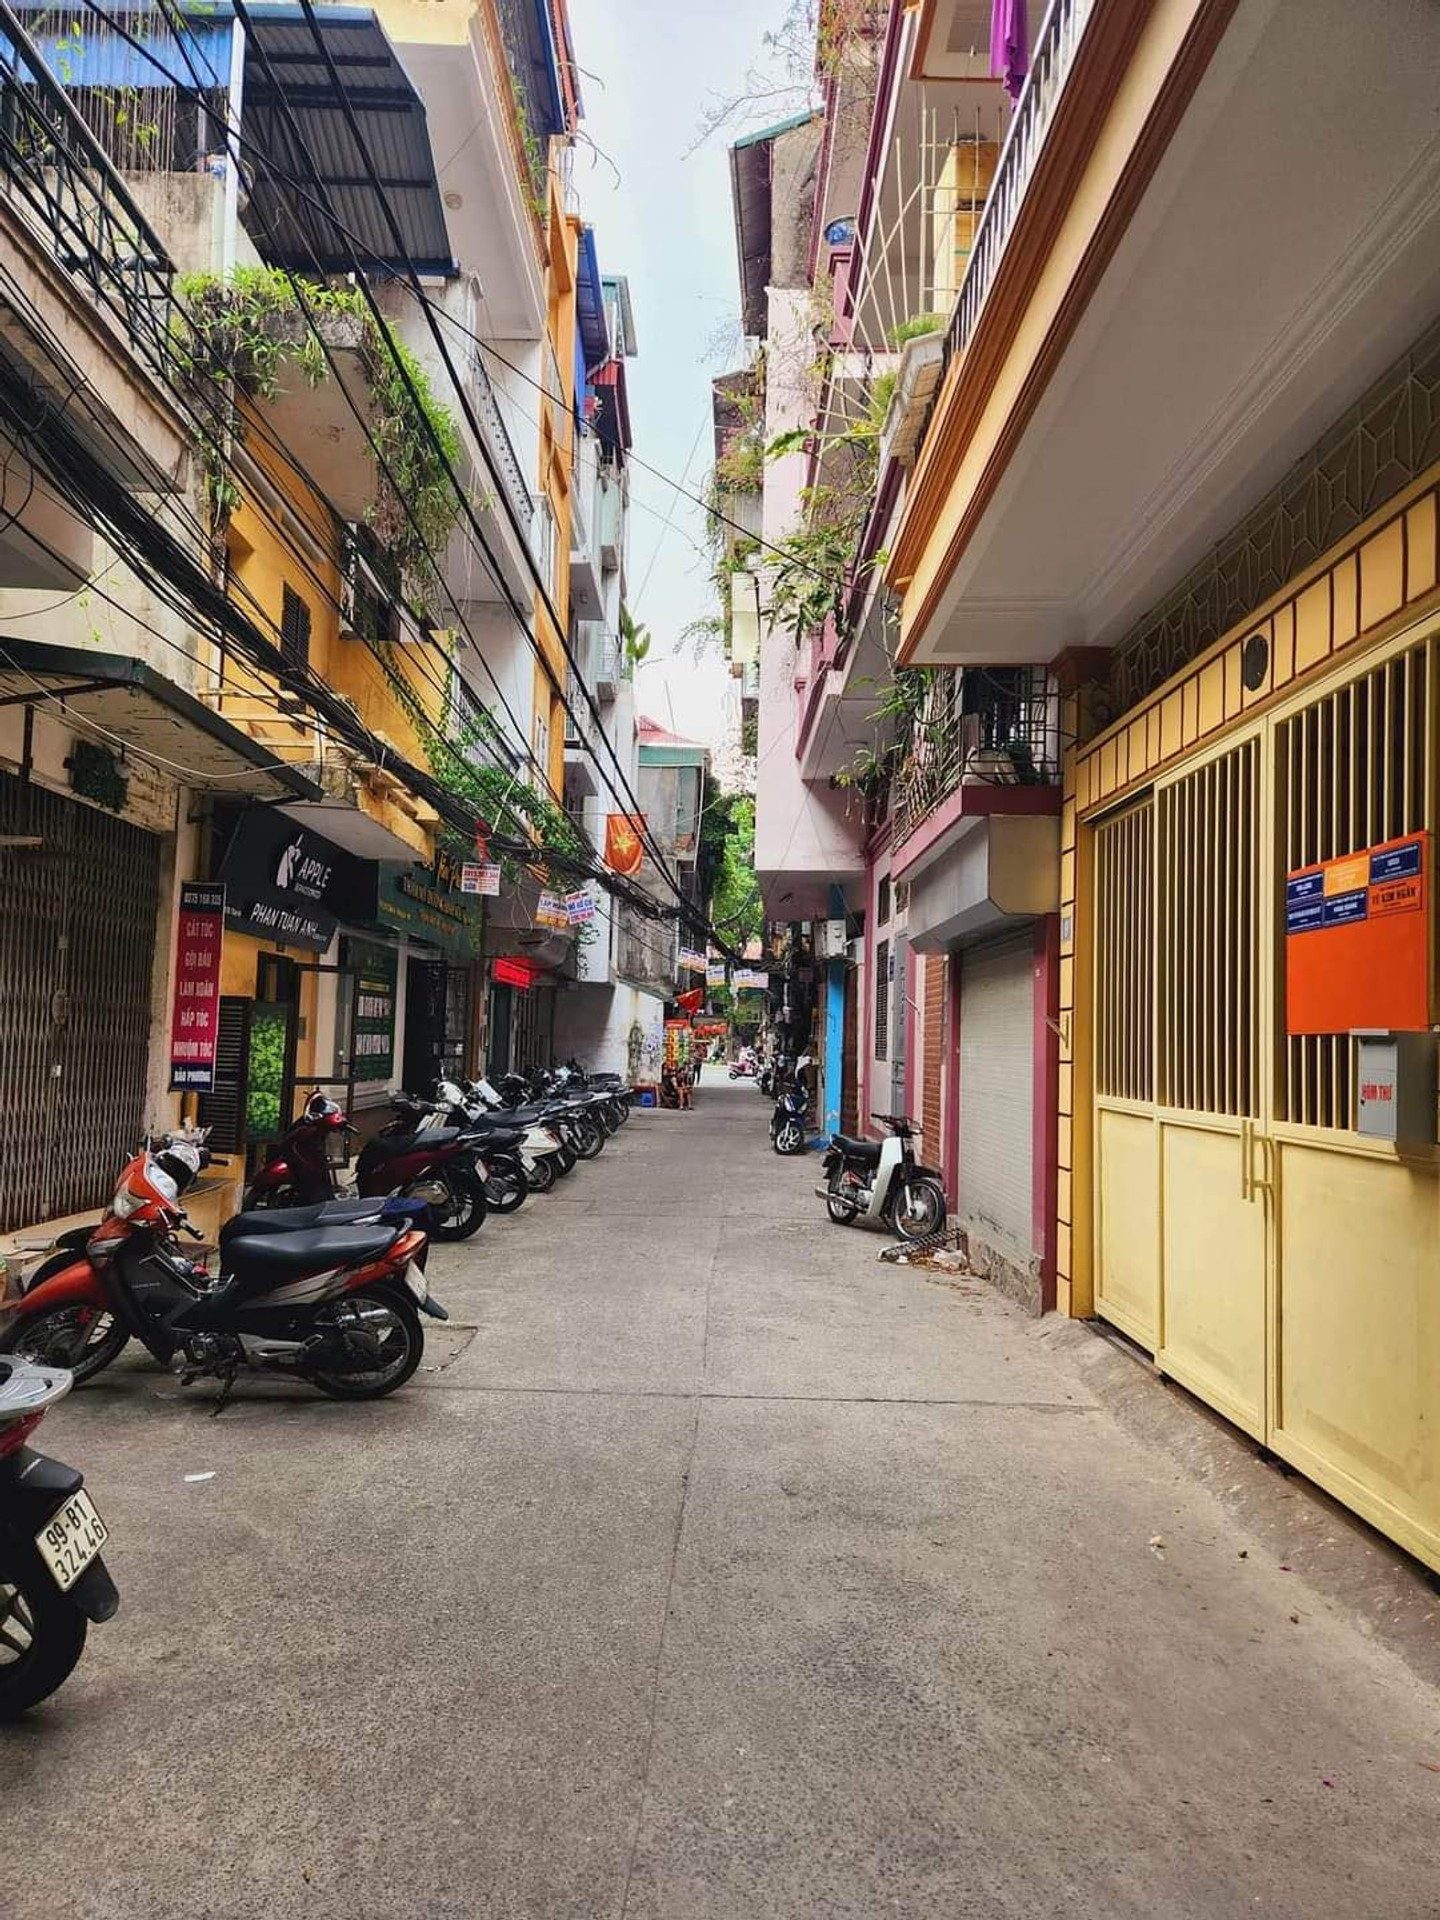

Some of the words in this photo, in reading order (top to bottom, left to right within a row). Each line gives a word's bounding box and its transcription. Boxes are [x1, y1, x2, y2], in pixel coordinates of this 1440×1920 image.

[298, 857, 331, 888] APPLE
[46, 1499, 88, 1553] 99-B1
[54, 1517, 105, 1583] 324.46
